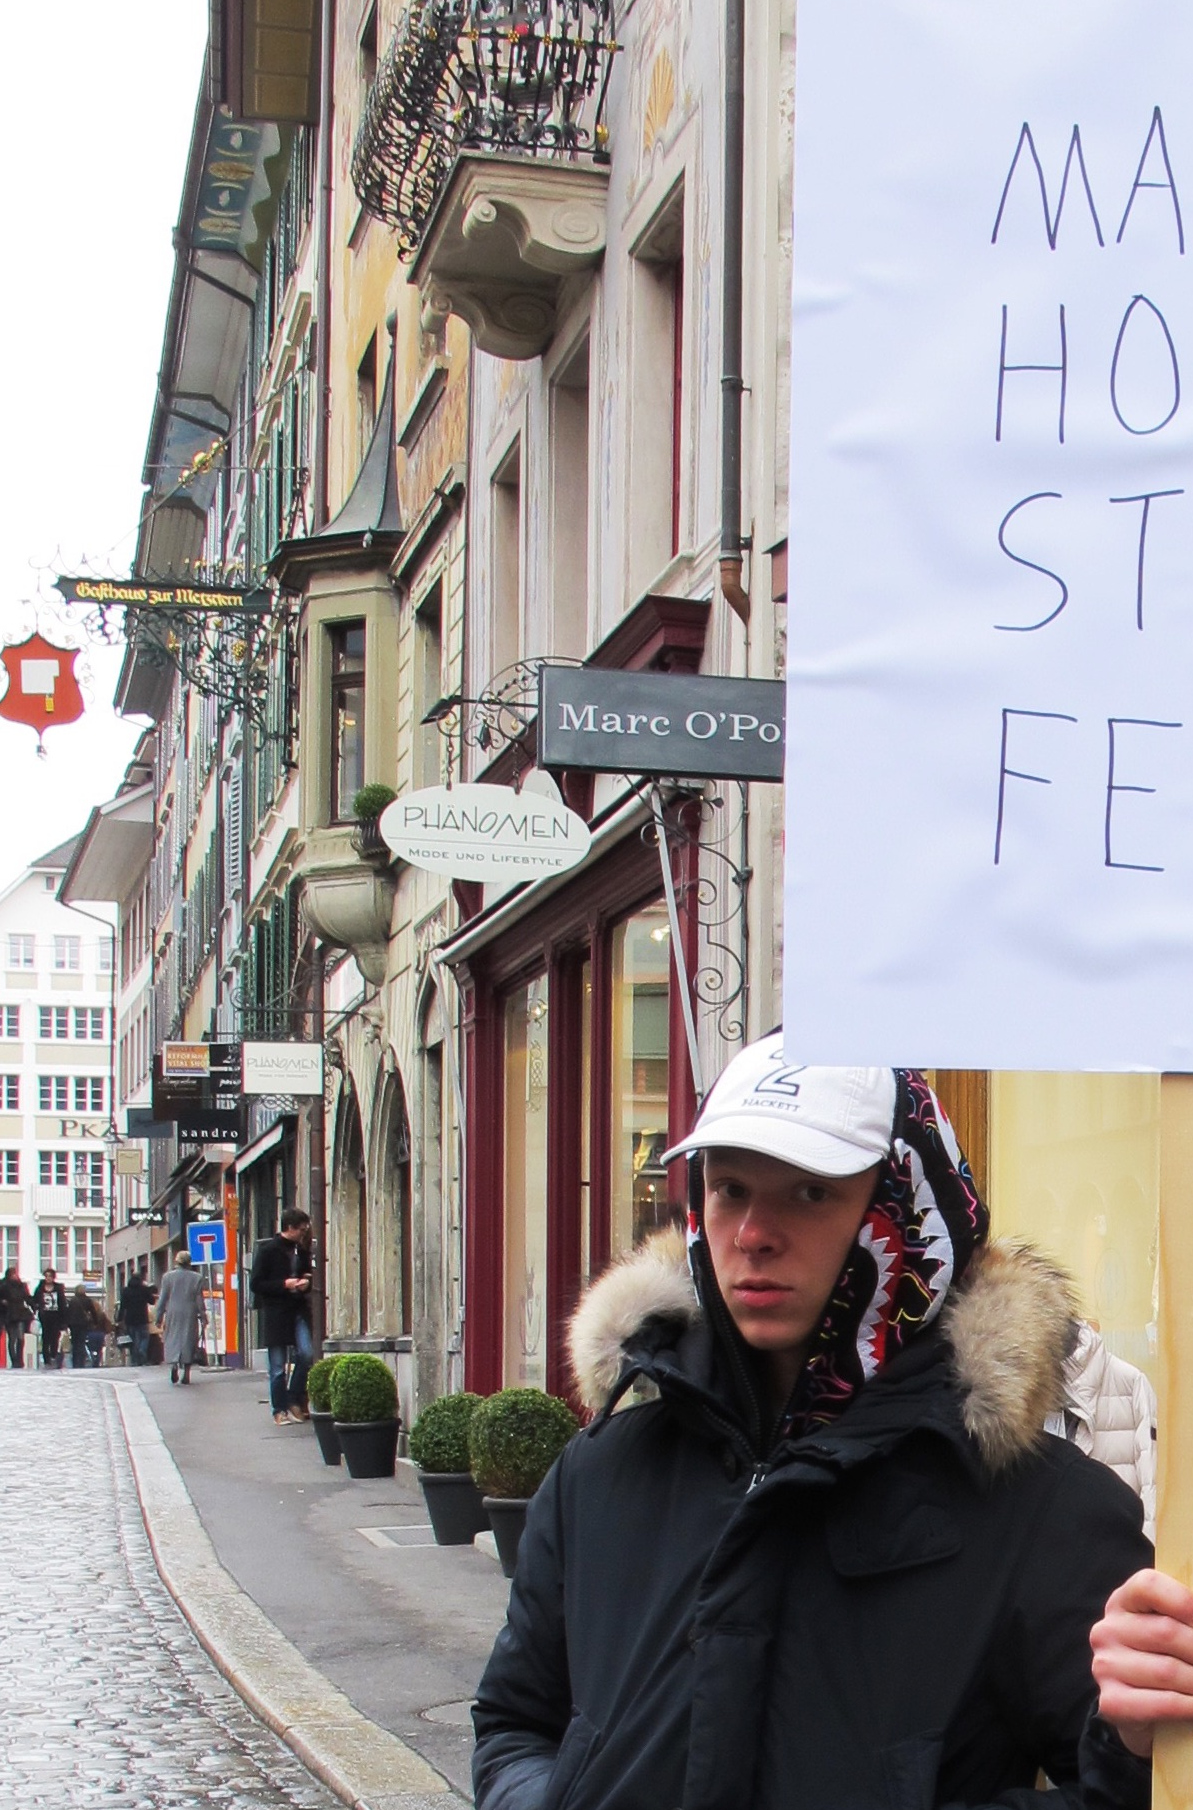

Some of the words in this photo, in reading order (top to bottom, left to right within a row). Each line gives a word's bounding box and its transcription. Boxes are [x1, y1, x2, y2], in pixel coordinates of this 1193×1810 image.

[75, 581, 147, 601] Gasthaus
[149, 589, 174, 605] zur
[558, 702, 671, 736] Marc
[685, 711, 785, 743] O'Po
[404, 803, 570, 841] PHÄNOMEN
[742, 1098, 801, 1112] HACKETT
[181, 1128, 239, 1138] sandro
